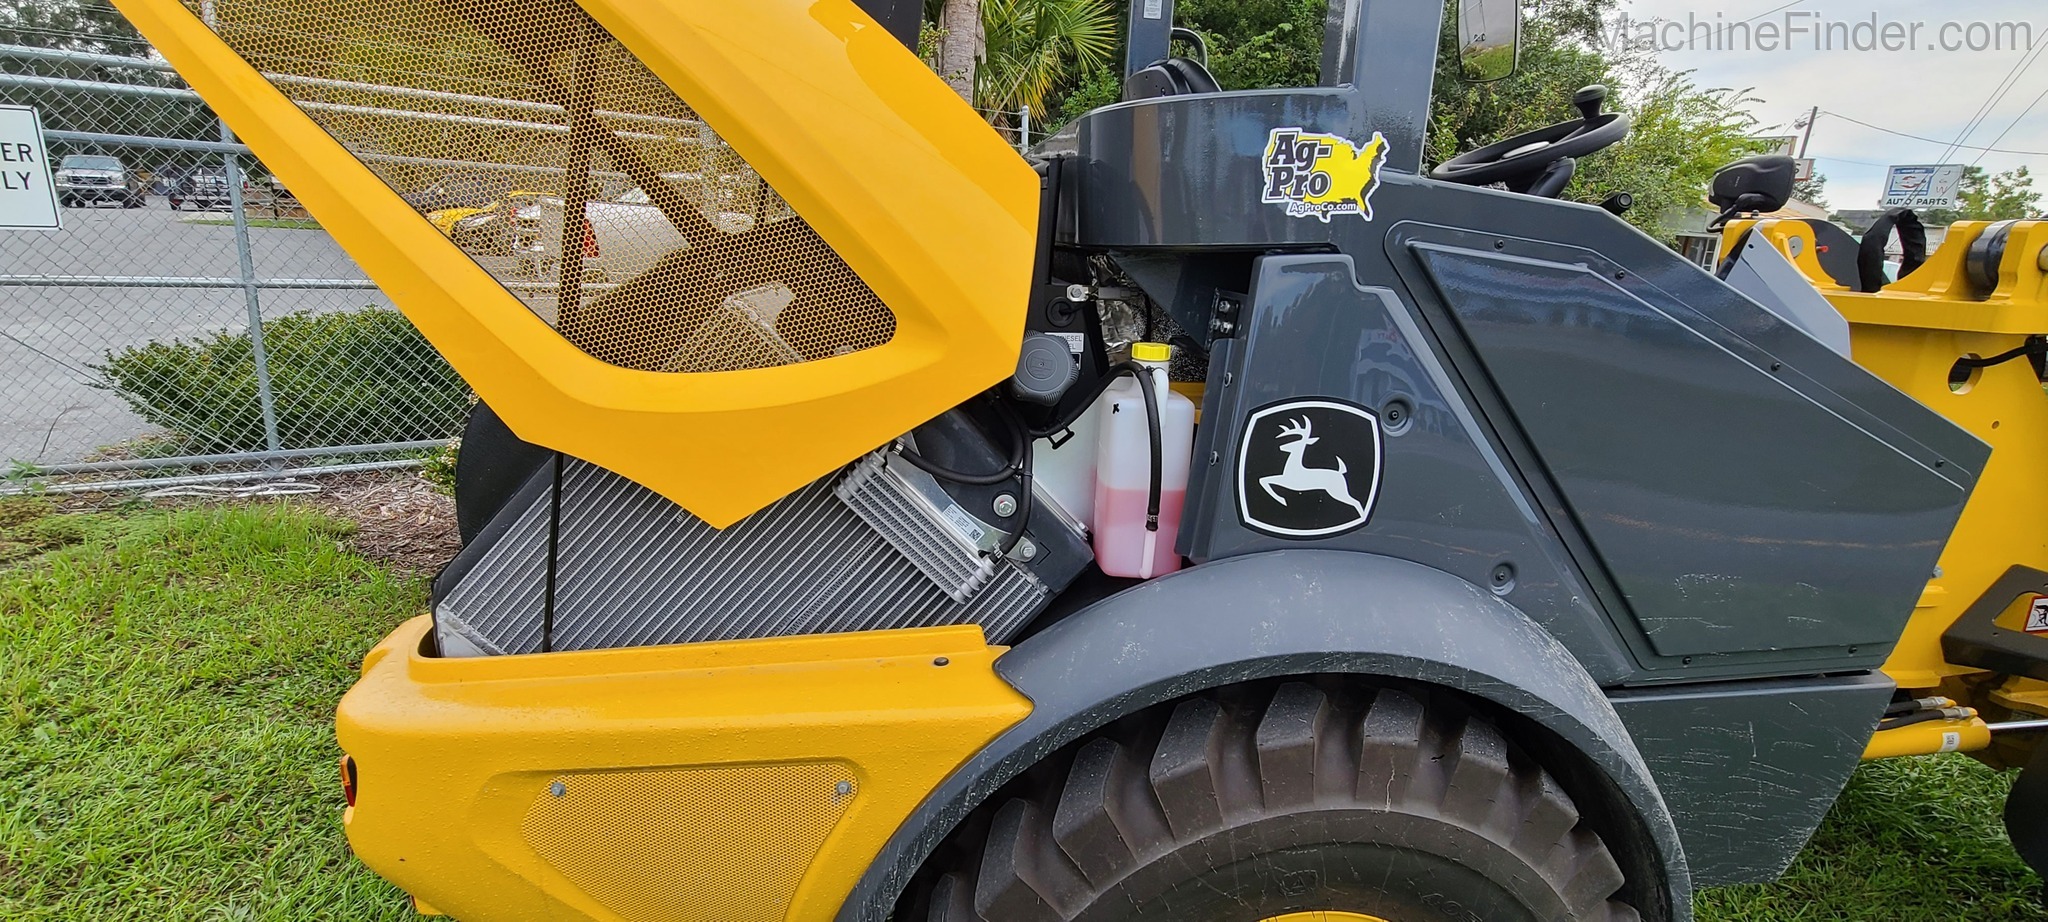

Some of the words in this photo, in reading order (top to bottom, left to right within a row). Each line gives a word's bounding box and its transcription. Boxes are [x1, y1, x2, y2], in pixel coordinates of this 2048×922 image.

[1268, 132, 1332, 172] Ag-
[1268, 166, 1331, 197] Pro
[1291, 202, 1358, 213] AgProCo.com
[1886, 198, 1912, 206] AUTO
[1916, 198, 1948, 206] PARTS
[1065, 334, 1082, 342] IESEL
